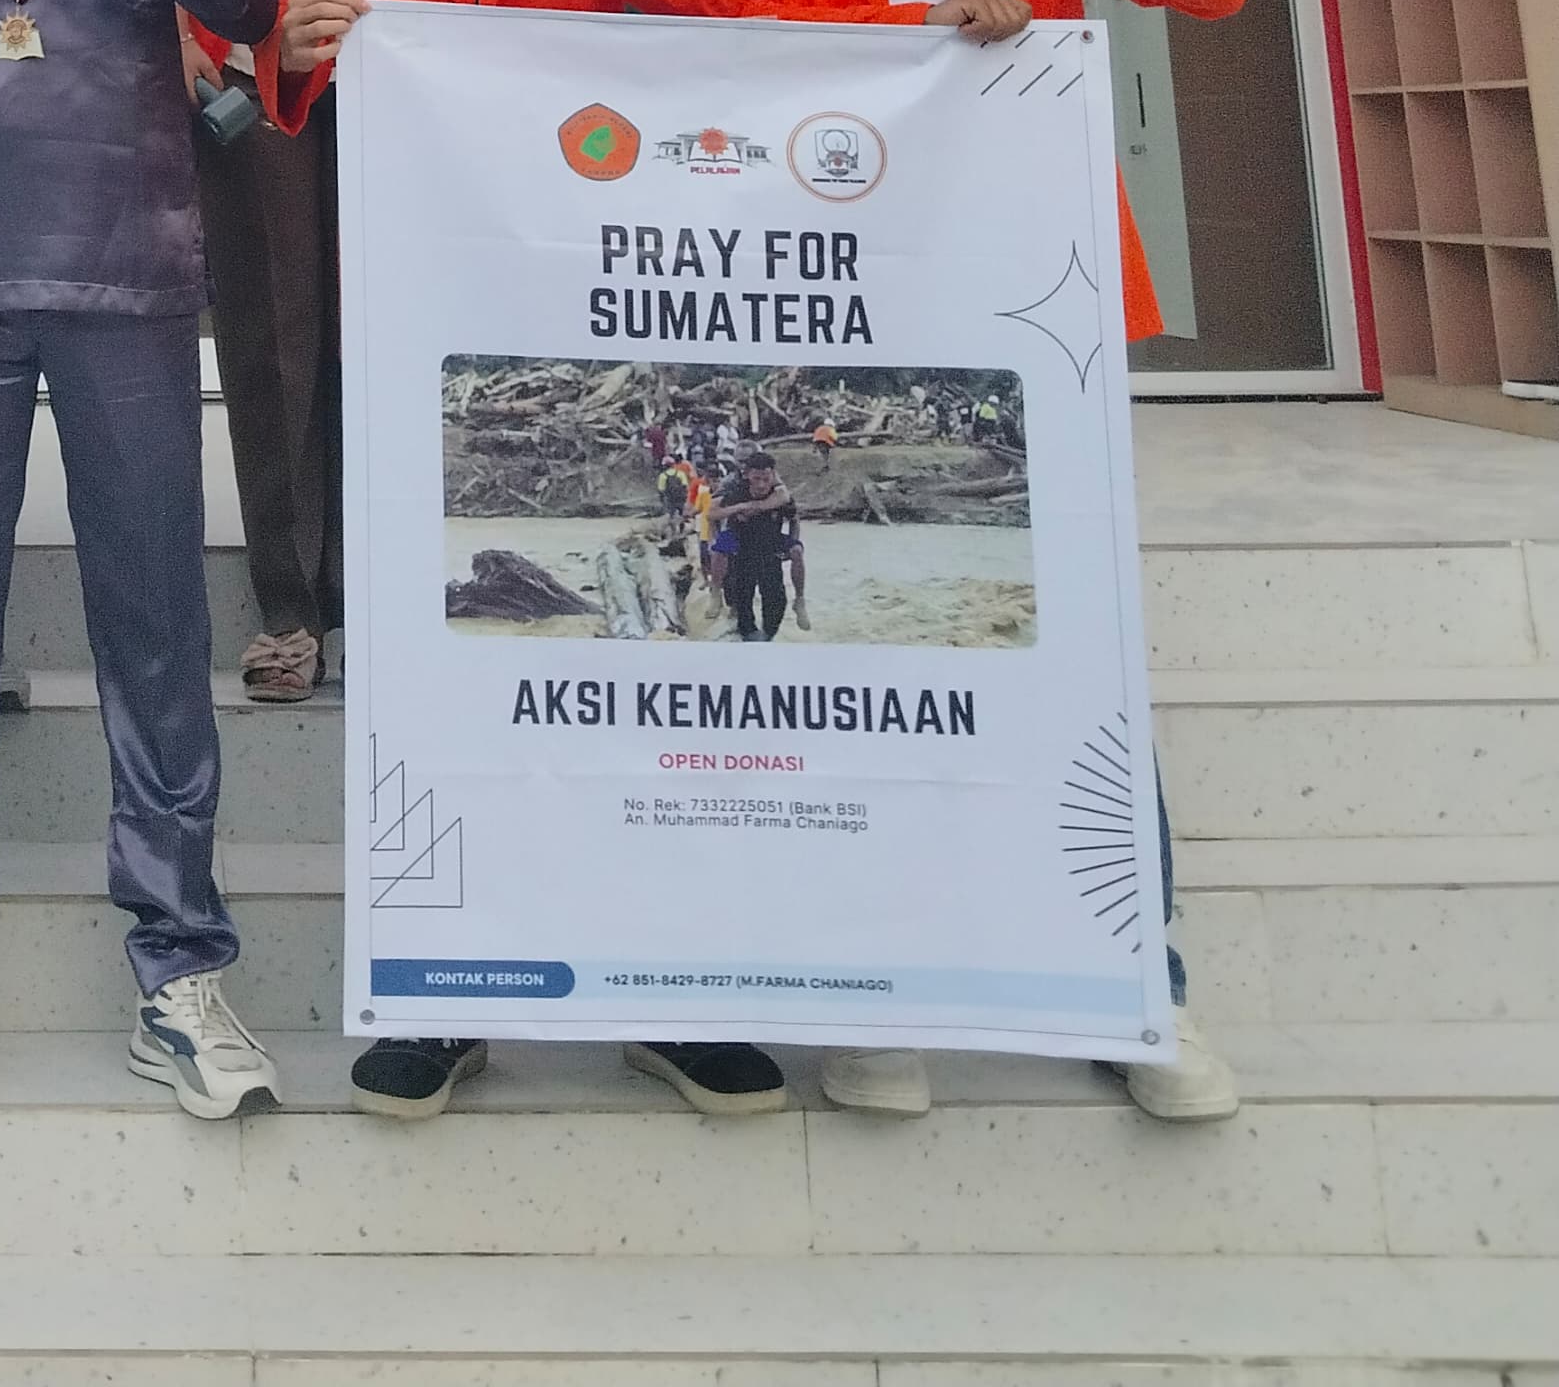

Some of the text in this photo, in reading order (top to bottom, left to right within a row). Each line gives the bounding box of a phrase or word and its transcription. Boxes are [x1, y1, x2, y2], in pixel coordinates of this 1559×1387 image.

[602, 225, 858, 281] PRAY FOR
[590, 288, 873, 344] SUMATERA
[513, 680, 975, 735] AKSI KEMANUSIAAN
[659, 754, 803, 771] OPEN DONASI
[655, 799, 684, 811] Rek:
[691, 799, 782, 813] 7332225051
[790, 802, 831, 815] (Bank
[837, 803, 866, 817] BSI)
[654, 813, 739, 826] Muhammad
[744, 814, 791, 828] Farma
[796, 816, 868, 833] Chaniago
[426, 973, 543, 985] KONTAK PERSON
[605, 975, 628, 985] +62
[633, 975, 732, 986] 851-8429-8727
[810, 978, 891, 992] CHANIAGO)
